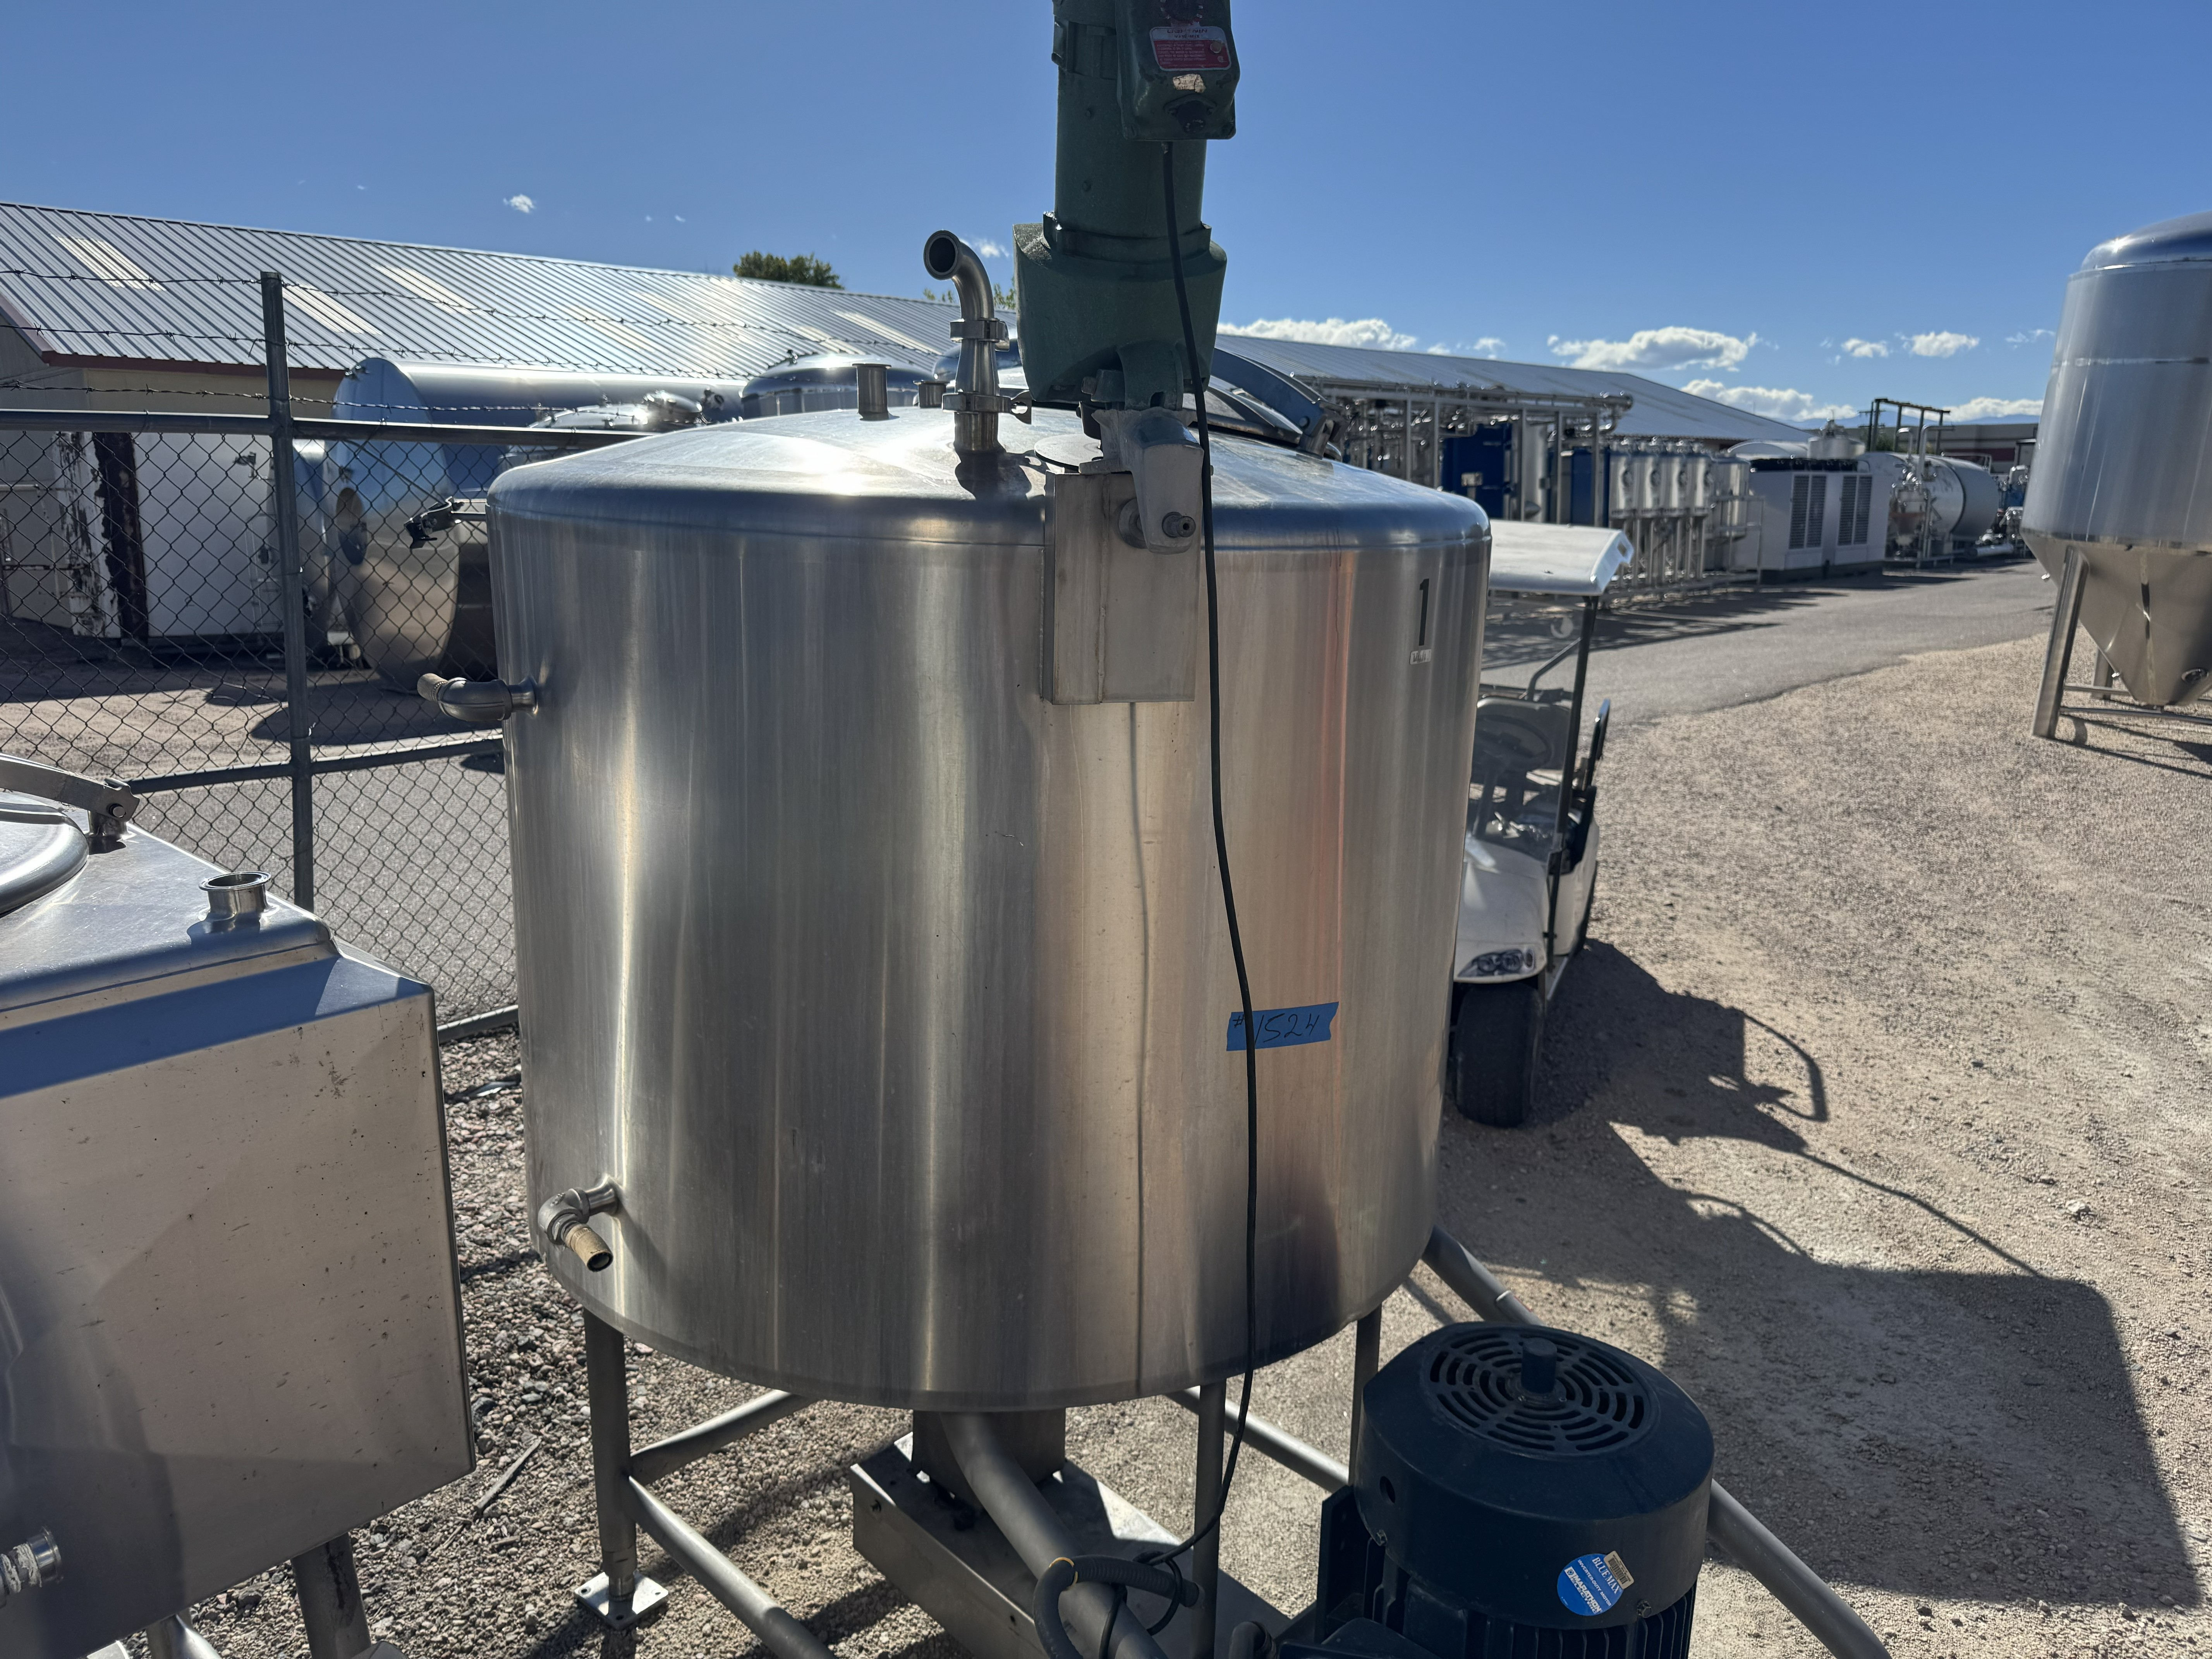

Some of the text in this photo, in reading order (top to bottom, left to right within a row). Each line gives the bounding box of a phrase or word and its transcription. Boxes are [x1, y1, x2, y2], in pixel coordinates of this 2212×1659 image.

[1419, 578, 1429, 646] 1
[1572, 1575, 1602, 1612] MARATHON
[1592, 1557, 1610, 1578] BLUE
[1605, 1575, 1619, 1594] MAX
[1570, 1578, 1597, 1614] ELECTRIC
[1600, 1591, 1611, 1607] MOTOR
